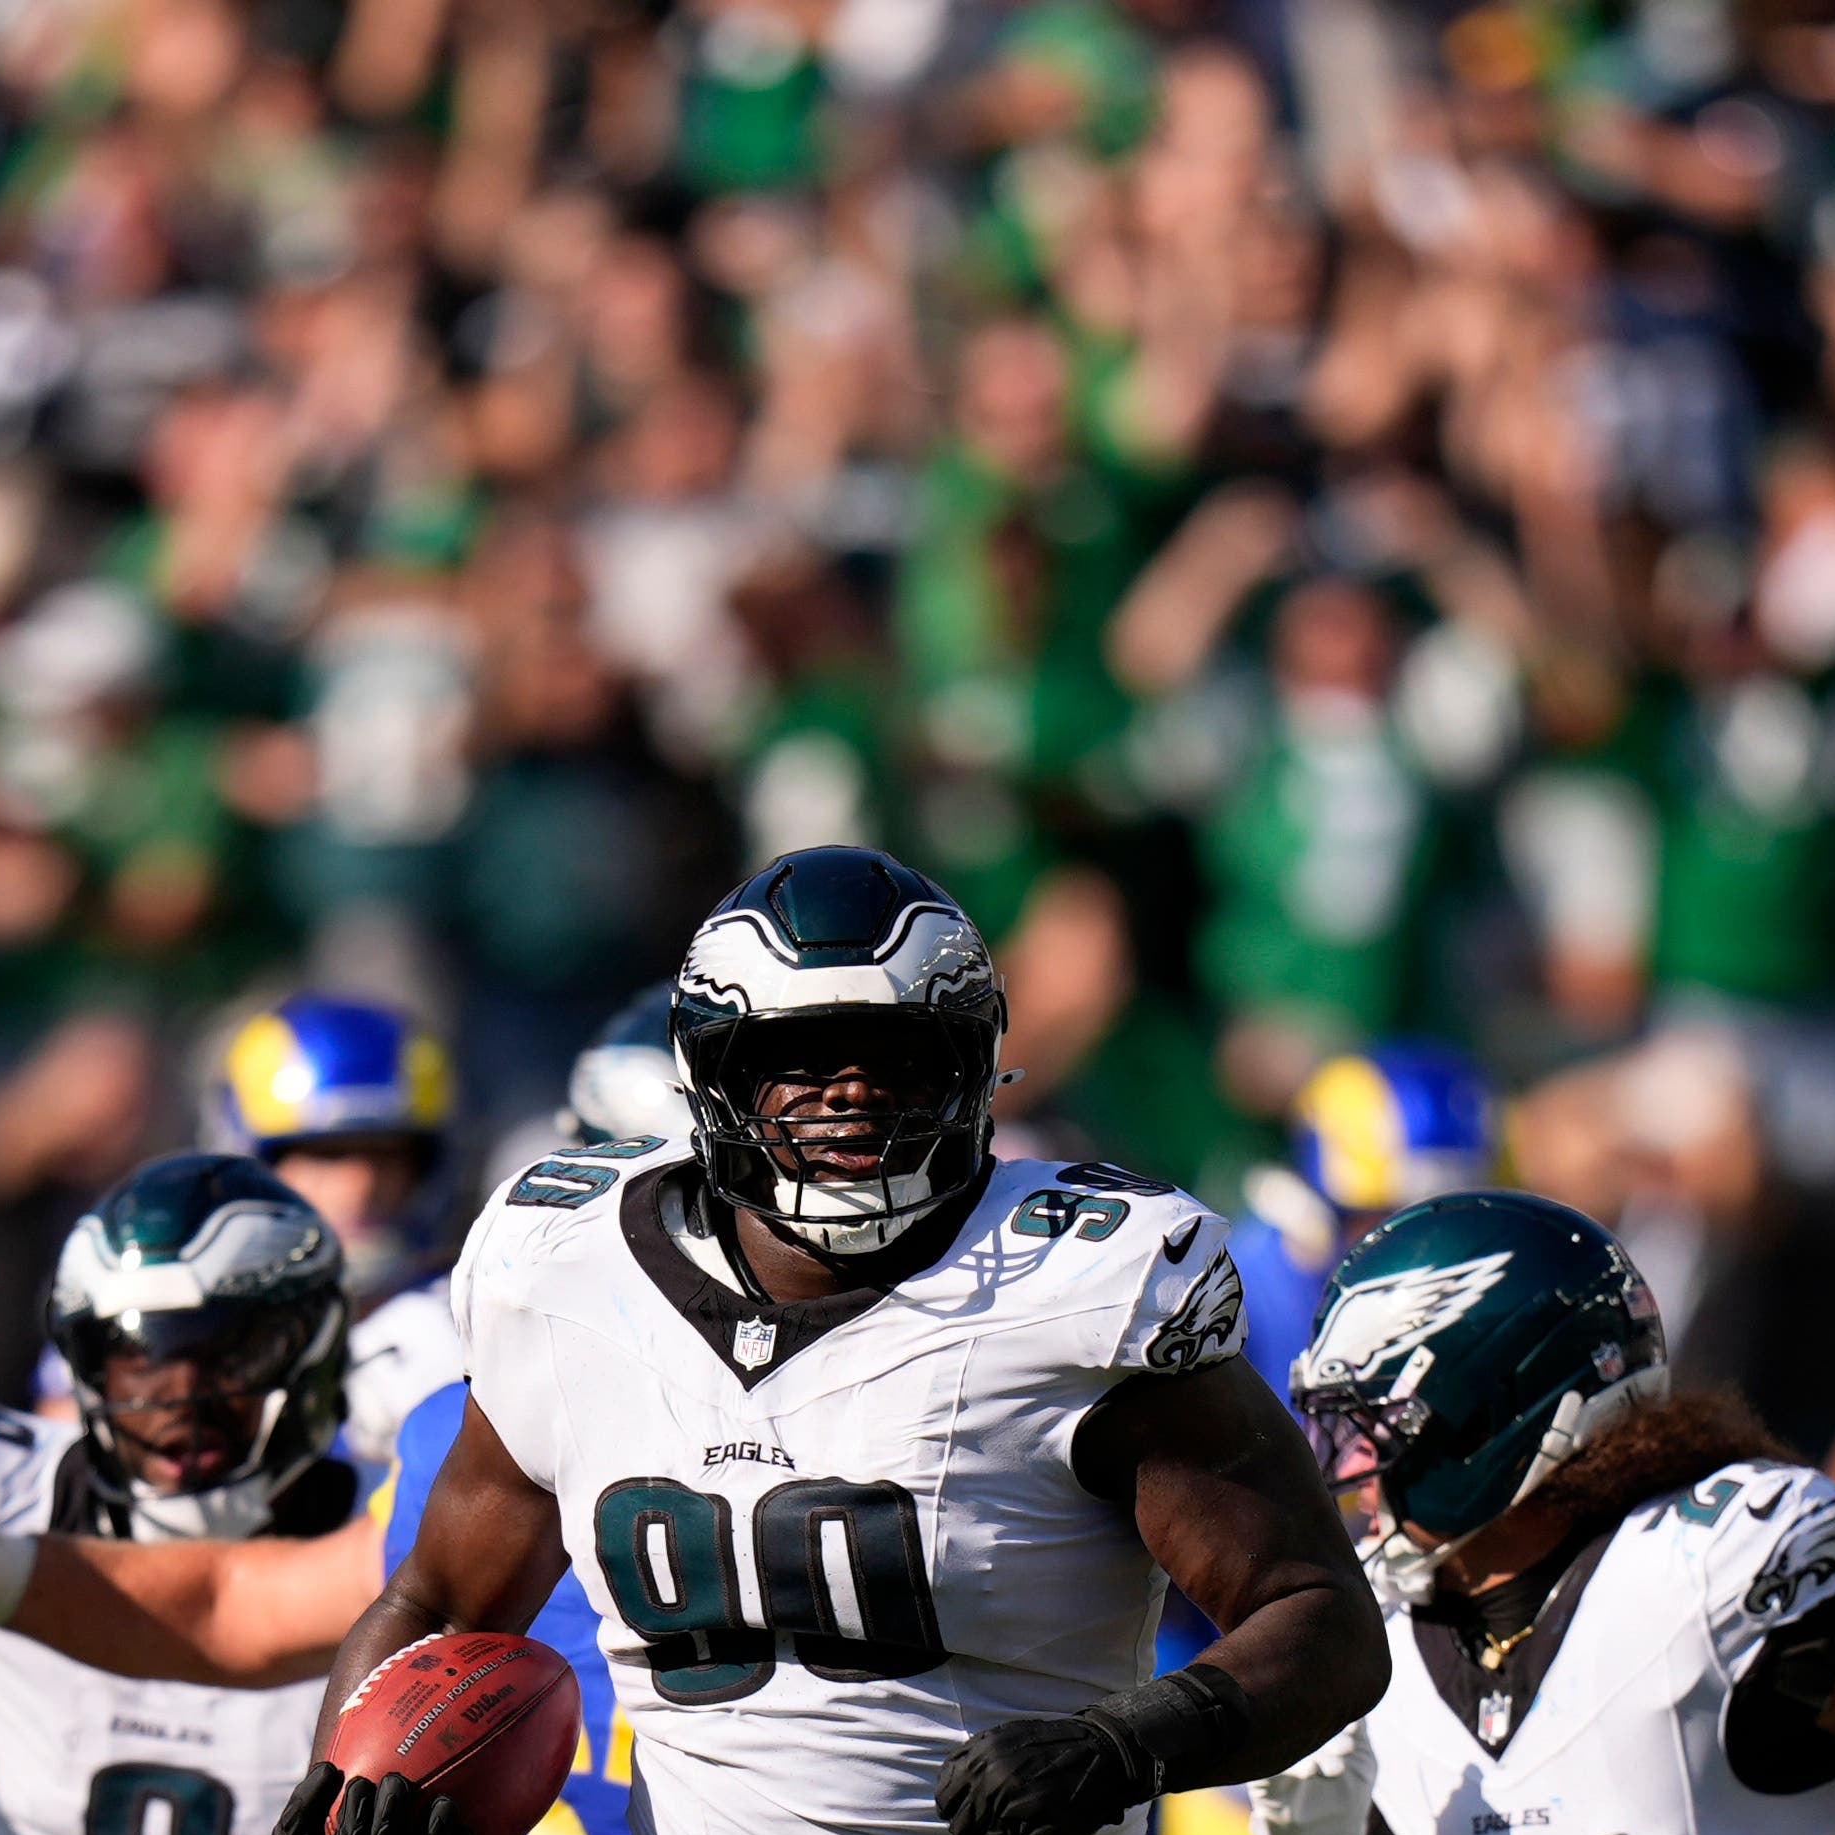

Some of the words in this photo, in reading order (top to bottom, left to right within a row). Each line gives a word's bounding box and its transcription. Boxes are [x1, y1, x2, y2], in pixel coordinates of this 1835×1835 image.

[594, 1476, 953, 1706] 90
[396, 1702, 448, 1757] NATIONAL
[446, 1661, 499, 1701] FOOTBALL
[1472, 1808, 1550, 1835] EAGLES
